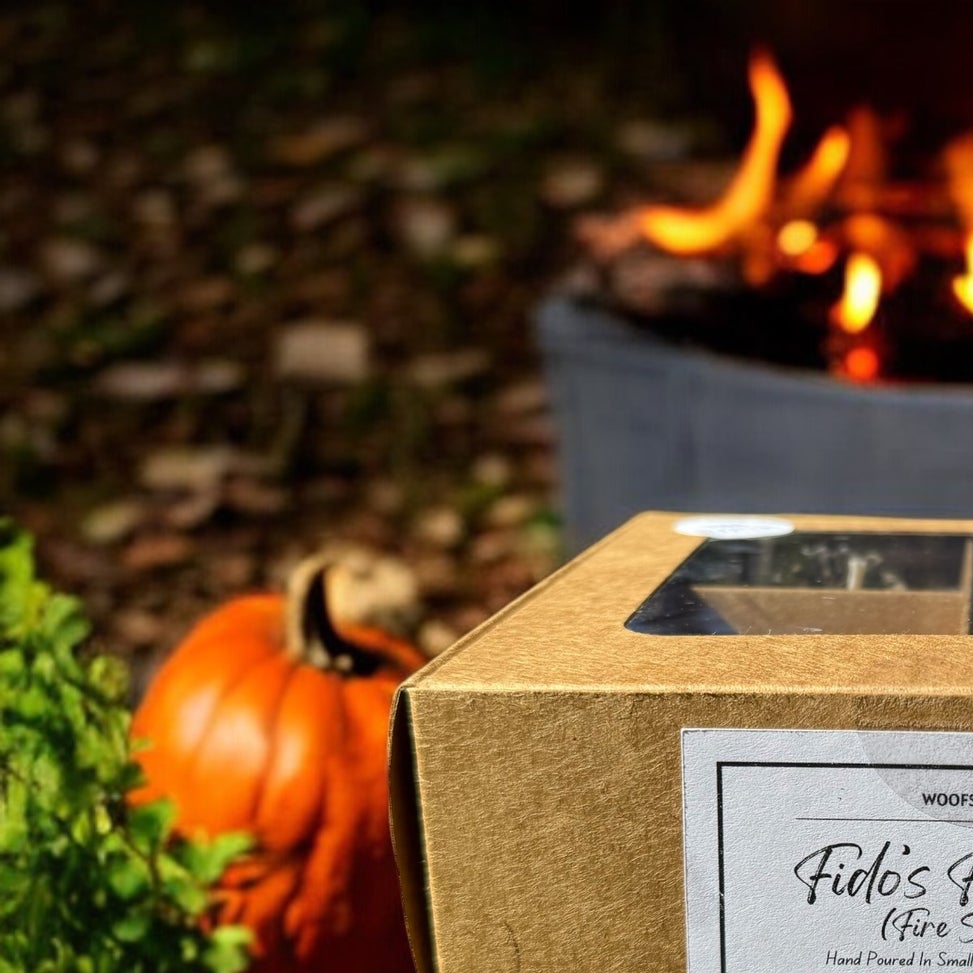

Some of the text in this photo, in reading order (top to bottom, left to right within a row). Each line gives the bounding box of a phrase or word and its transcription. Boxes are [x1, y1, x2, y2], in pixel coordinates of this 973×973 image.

[794, 841, 931, 905] Fido's
[881, 907, 950, 942] (Fire
[825, 950, 863, 966] Hand
[866, 950, 915, 967] Poured
[919, 951, 932, 967] In
